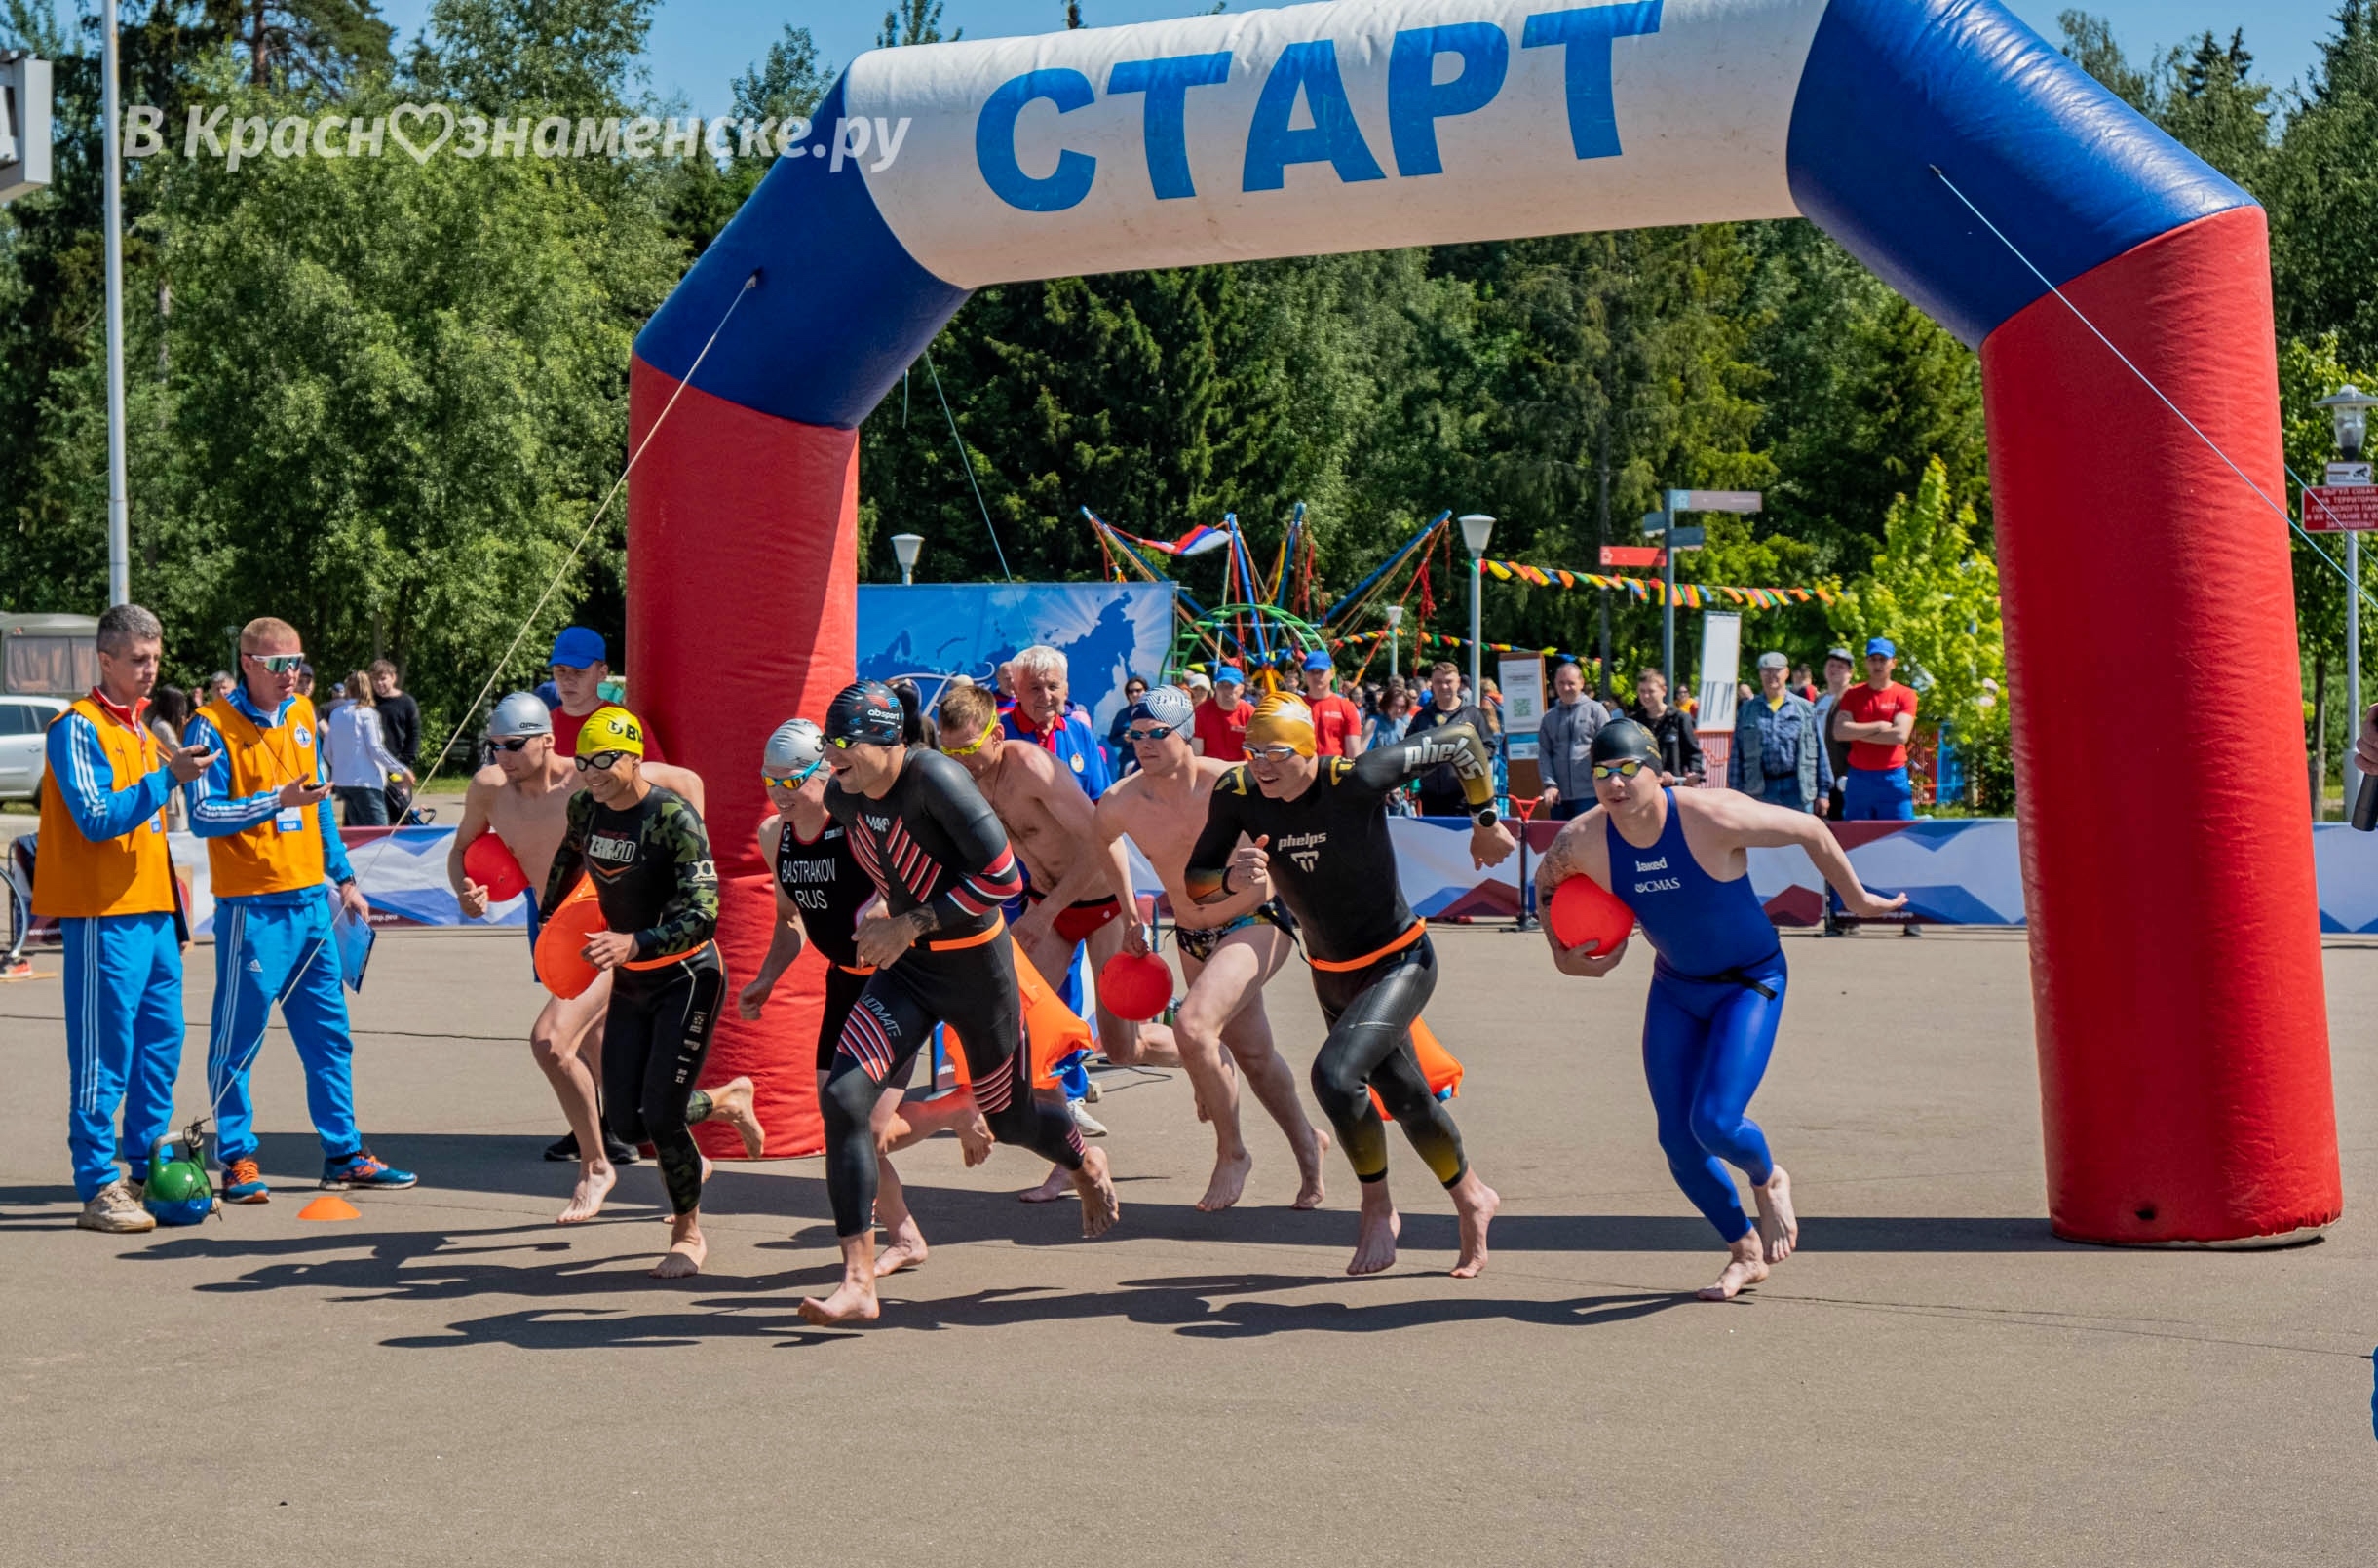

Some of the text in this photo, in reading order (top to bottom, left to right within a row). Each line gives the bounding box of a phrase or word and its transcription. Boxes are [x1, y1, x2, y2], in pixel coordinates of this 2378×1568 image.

[975, 0, 1662, 212] СТАРТ
[1403, 735, 1485, 781] phelps
[1277, 832, 1327, 852] phelps
[781, 857, 836, 883] BASTRAKOV
[1644, 877, 1681, 892] CMAS
[794, 889, 828, 910] RUS
